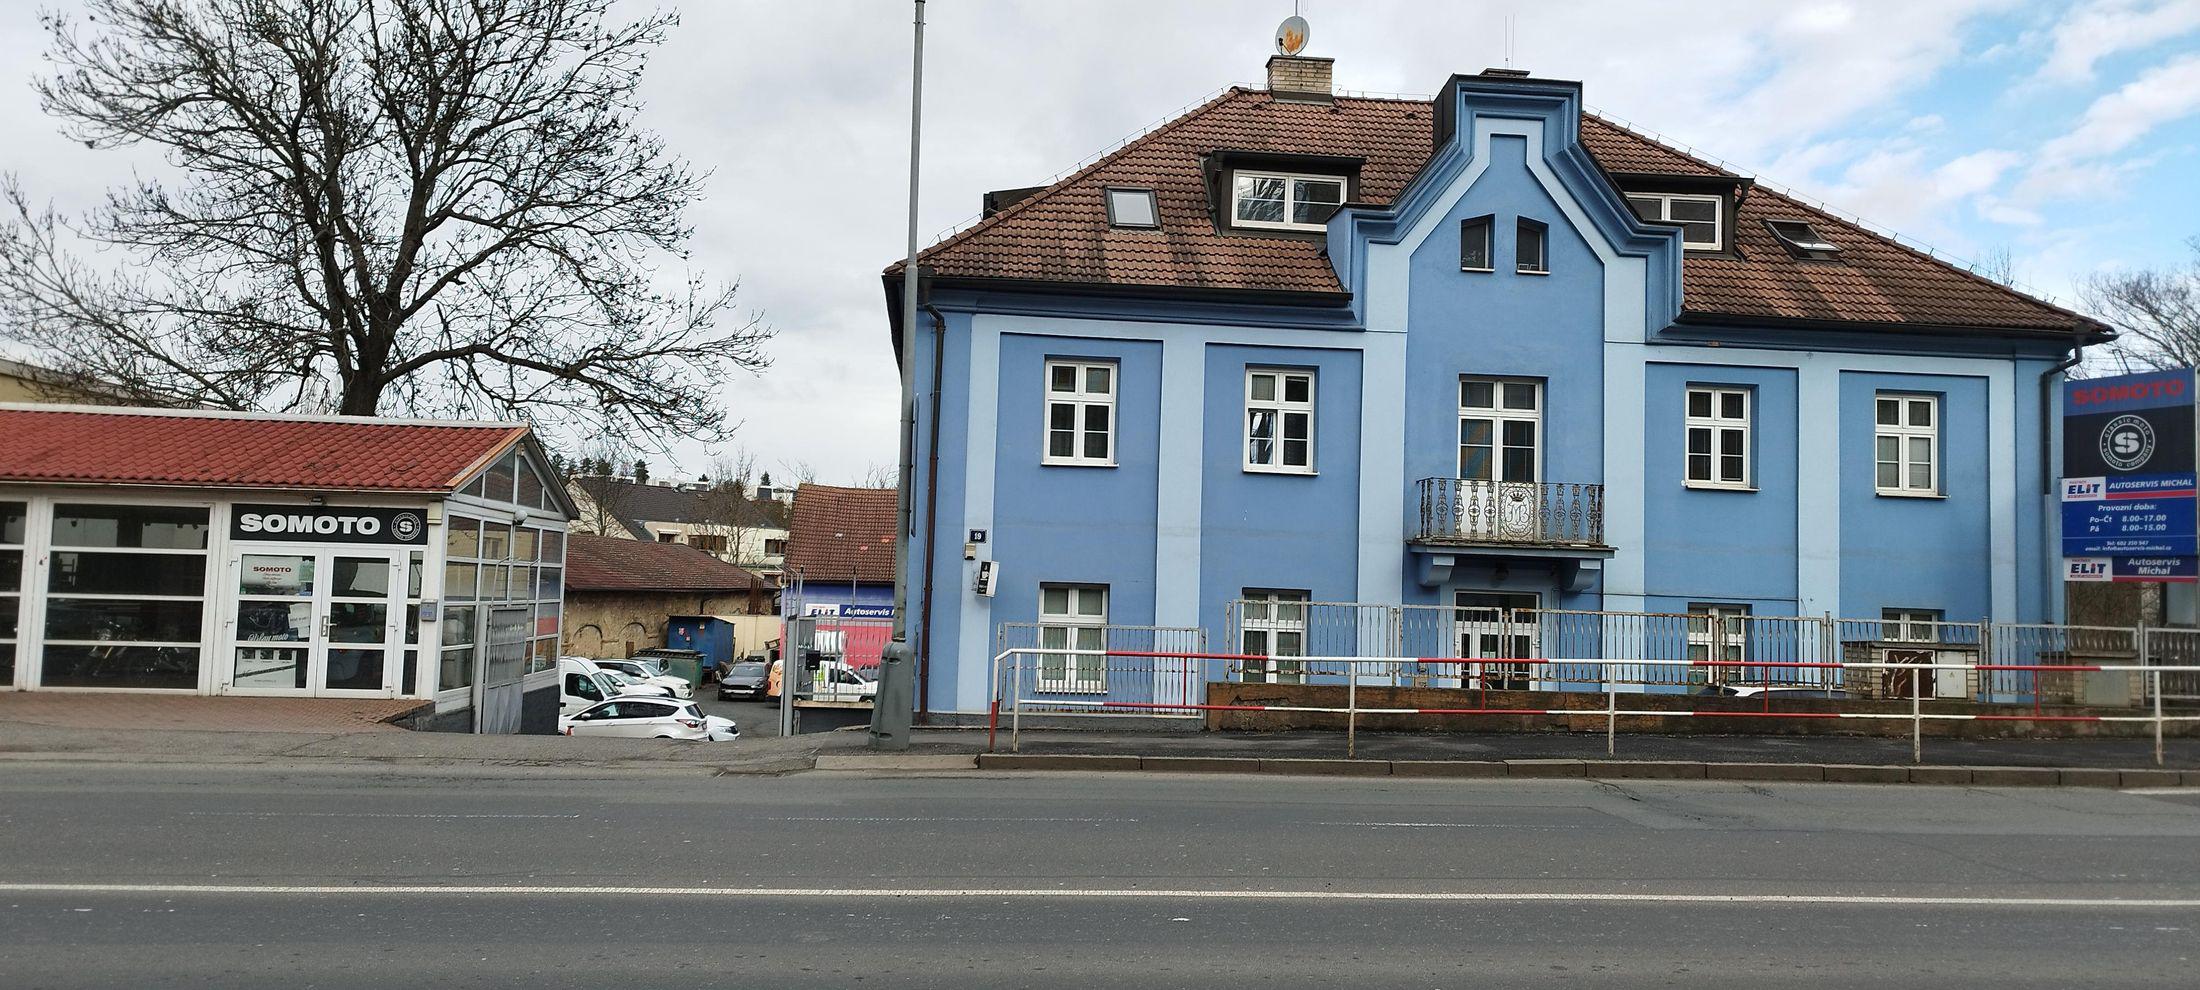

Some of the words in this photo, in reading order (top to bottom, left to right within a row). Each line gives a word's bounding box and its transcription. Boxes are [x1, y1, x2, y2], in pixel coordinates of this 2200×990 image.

[2072, 380, 2185, 406] SOMOTO
[2114, 431, 2140, 454] S
[2109, 480, 2159, 489] AUTOSERVIS
[2160, 478, 2193, 487] MICHAL
[2098, 503, 2133, 511] Provozní
[2133, 503, 2157, 511] doba:
[239, 513, 381, 535] SOMOTO
[974, 532, 982, 540] 19
[2127, 557, 2181, 566] Autoservis
[2137, 566, 2171, 575] Michal
[844, 607, 890, 616] Autoservis
